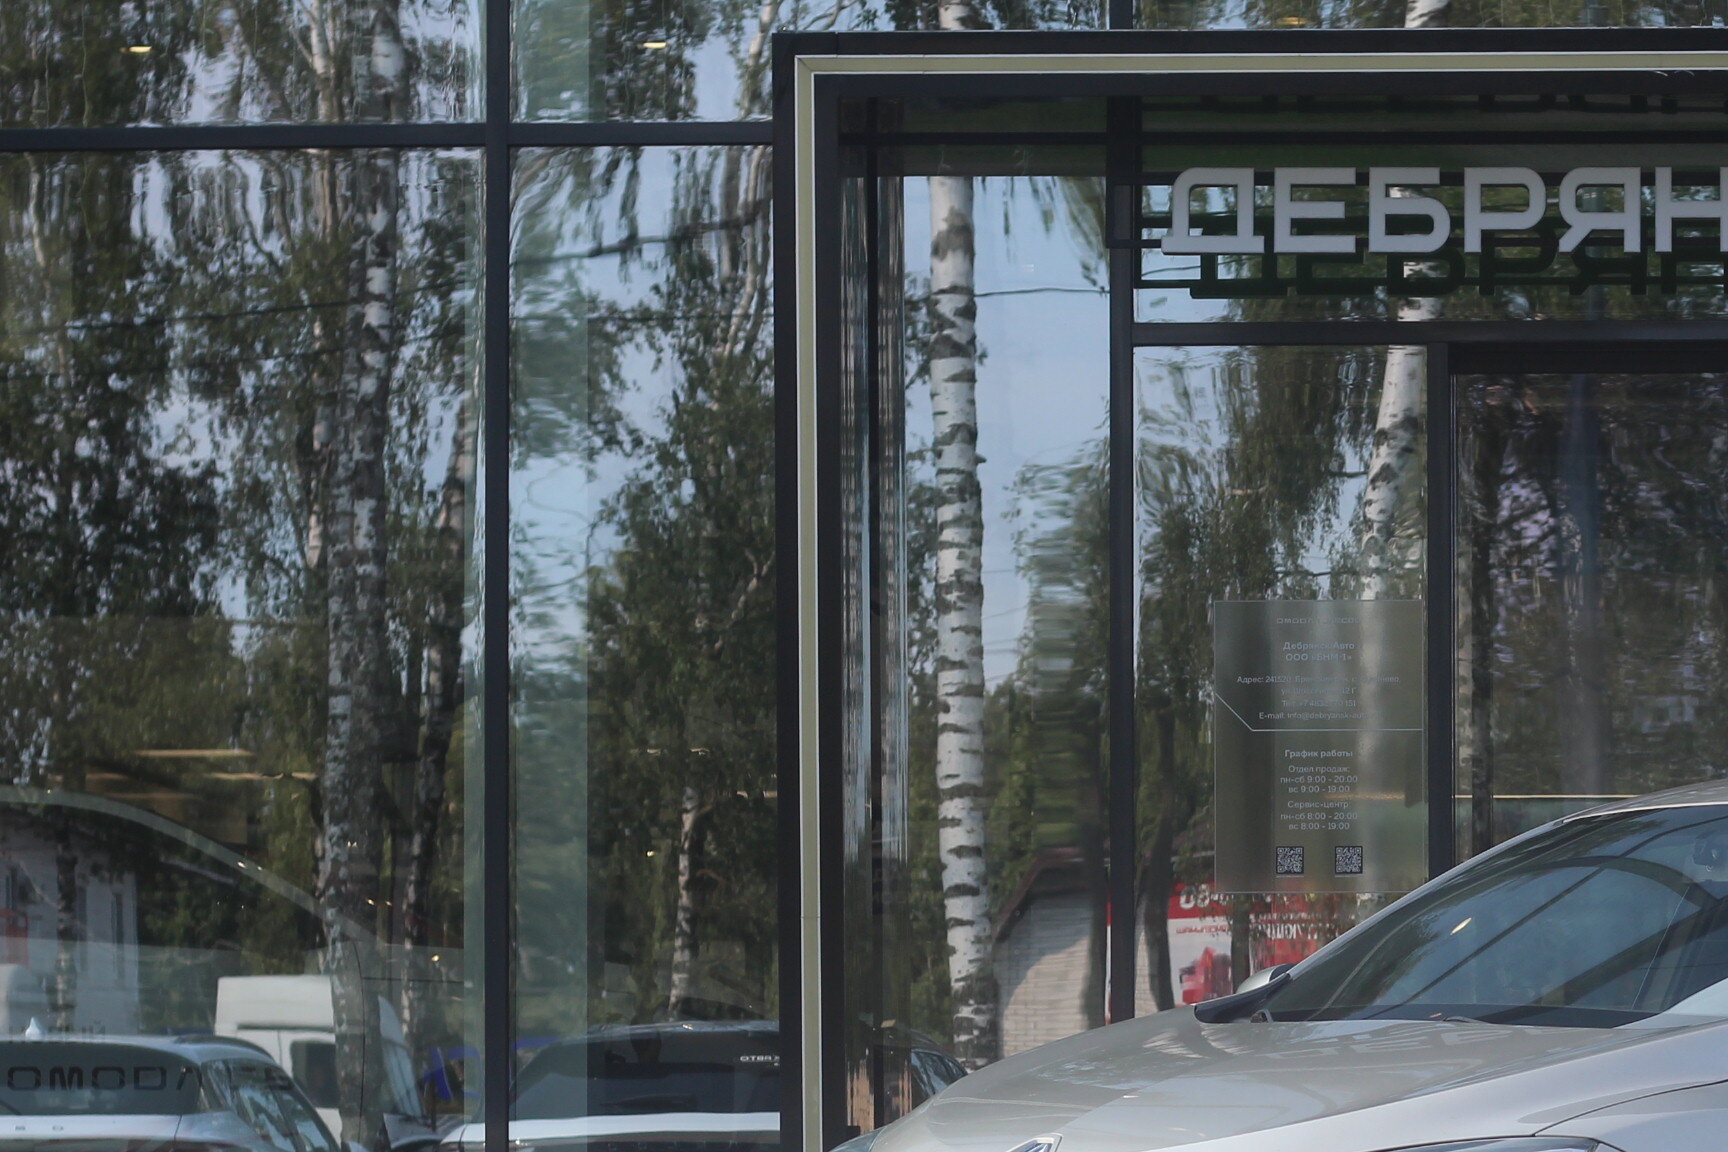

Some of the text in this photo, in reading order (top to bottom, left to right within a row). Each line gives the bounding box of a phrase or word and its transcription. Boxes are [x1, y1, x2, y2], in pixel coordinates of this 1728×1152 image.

[1284, 750, 1353, 758] График работы
[1288, 765, 1314, 773] Отдел
